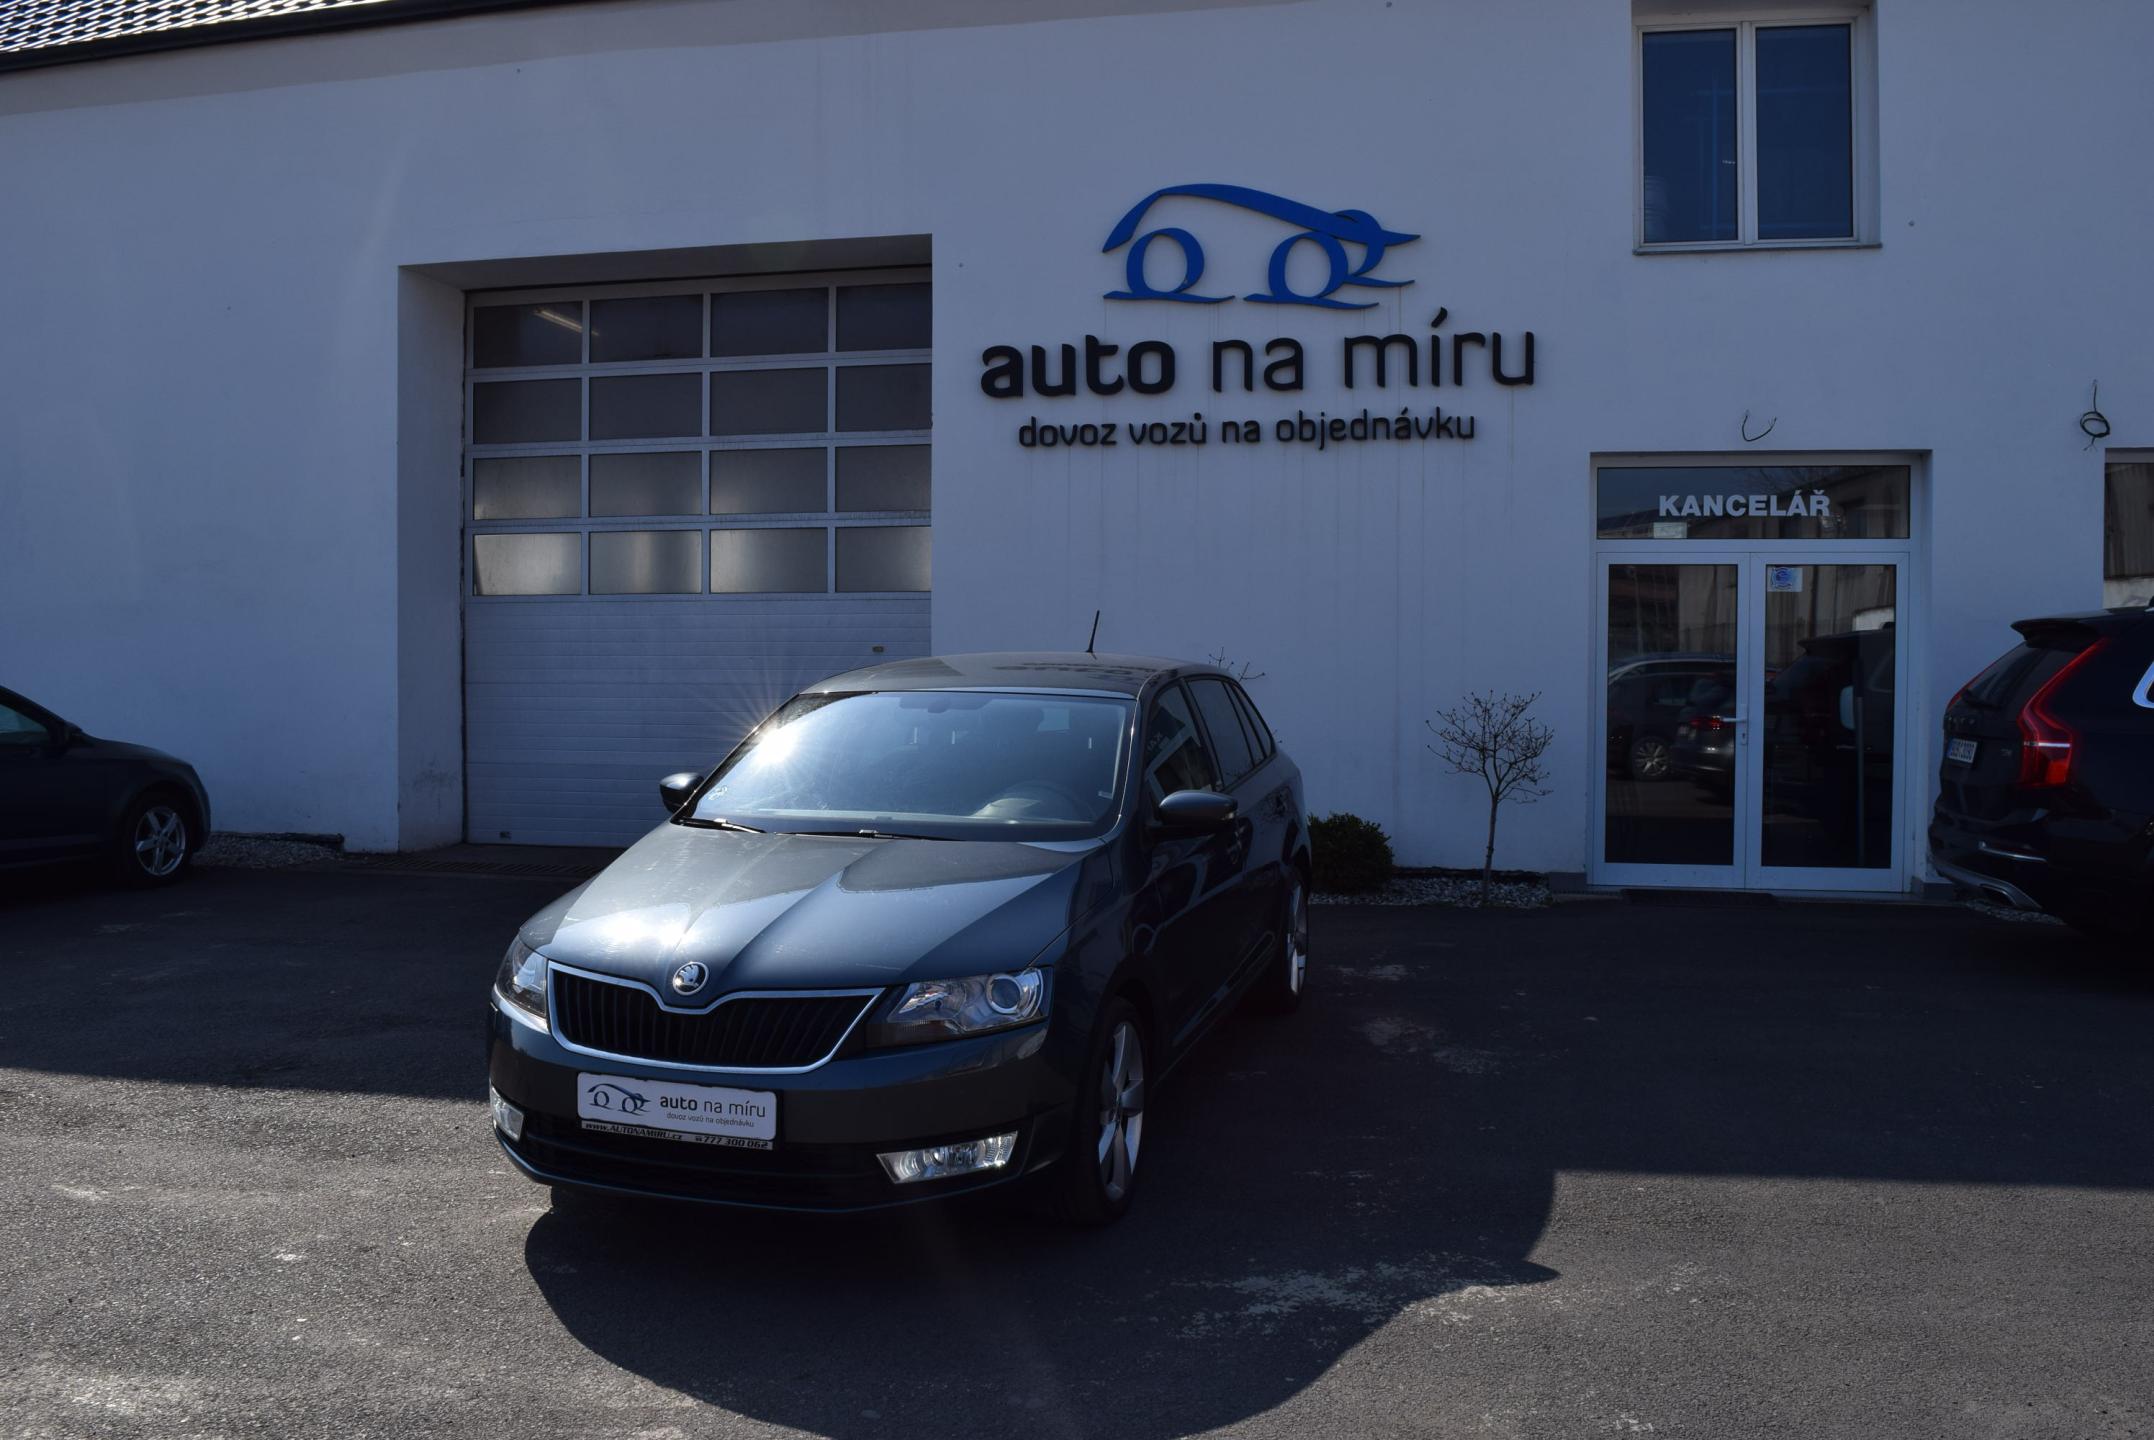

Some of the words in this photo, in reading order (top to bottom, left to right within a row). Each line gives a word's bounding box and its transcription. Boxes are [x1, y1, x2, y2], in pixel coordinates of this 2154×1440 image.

[981, 334, 1176, 398] auto
[1213, 337, 1304, 393] na
[1344, 307, 1535, 390] míru
[1018, 416, 1117, 447] dovoz
[1129, 412, 1208, 445] vozů
[1222, 417, 1261, 444] na
[1276, 406, 1476, 450] objednávku
[1658, 489, 1831, 518] KANCELÁŘ
[660, 1095, 698, 1111] auto
[704, 1100, 723, 1114] na
[728, 1100, 766, 1118] míru
[666, 1112, 687, 1121] dovoz
[688, 1114, 704, 1123] vozů
[716, 1117, 755, 1128] objednávku
[703, 1136, 722, 1145] 777
[725, 1138, 745, 1147] 300
